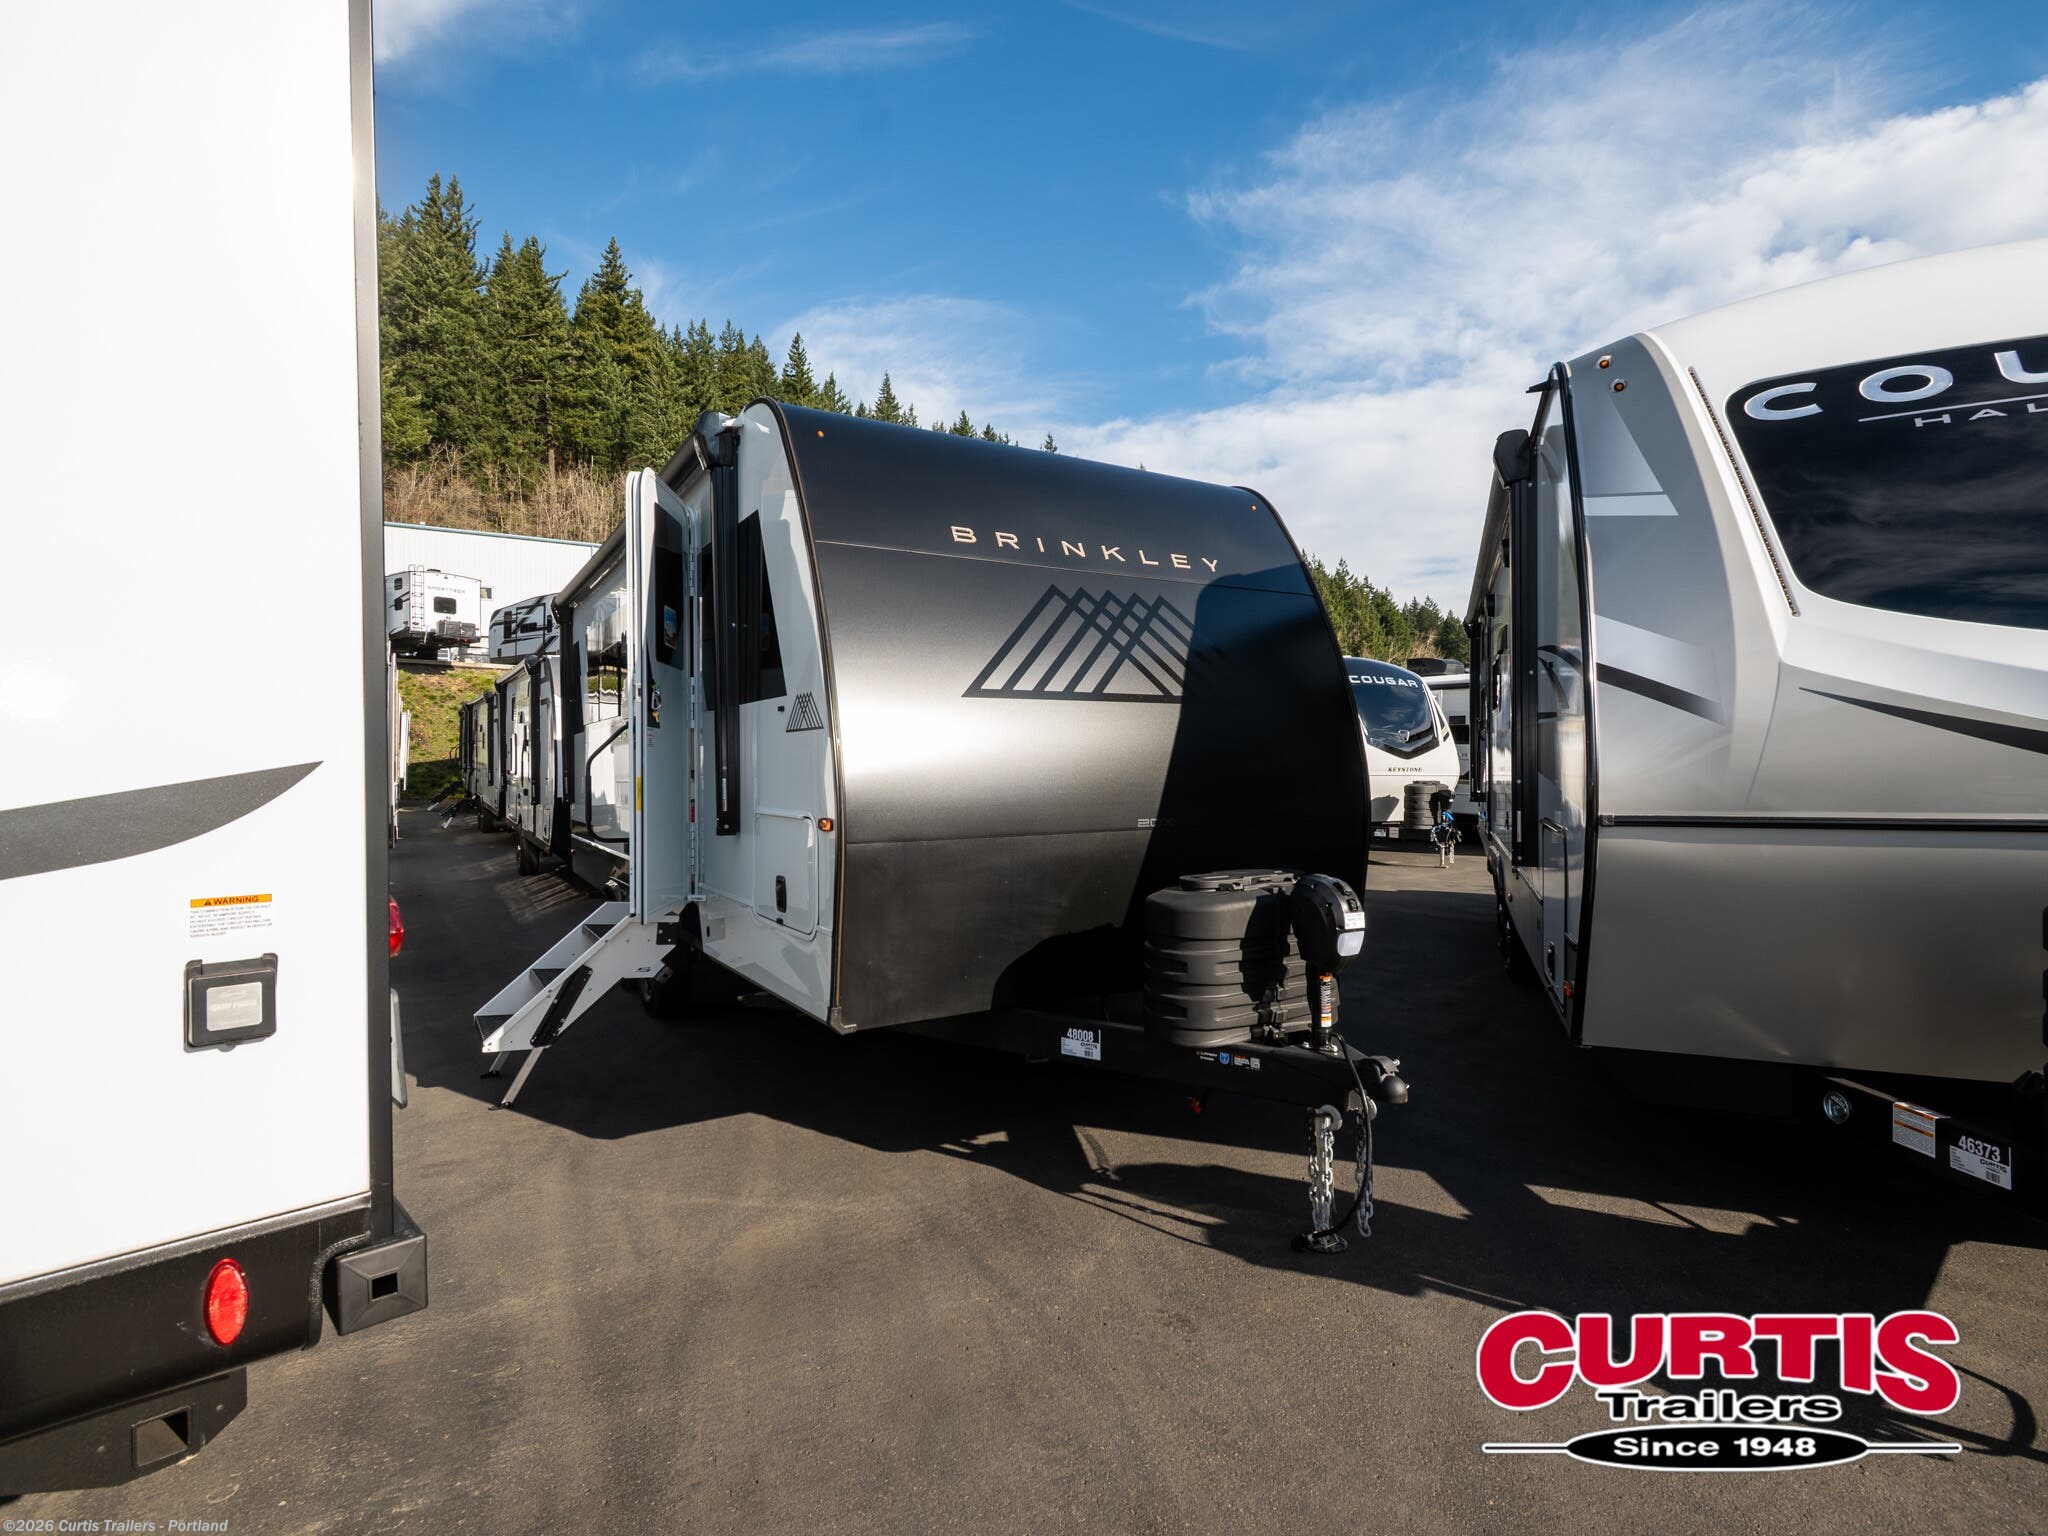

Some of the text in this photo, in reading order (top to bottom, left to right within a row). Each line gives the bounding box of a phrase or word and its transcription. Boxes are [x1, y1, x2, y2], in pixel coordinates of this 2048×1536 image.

[951, 526, 1218, 572] BRINKLEY
[1348, 675, 1418, 688] COUGAR
[213, 895, 259, 905] WARNING
[1067, 1027, 1094, 1042] 48008
[1958, 1135, 2001, 1163] 46373
